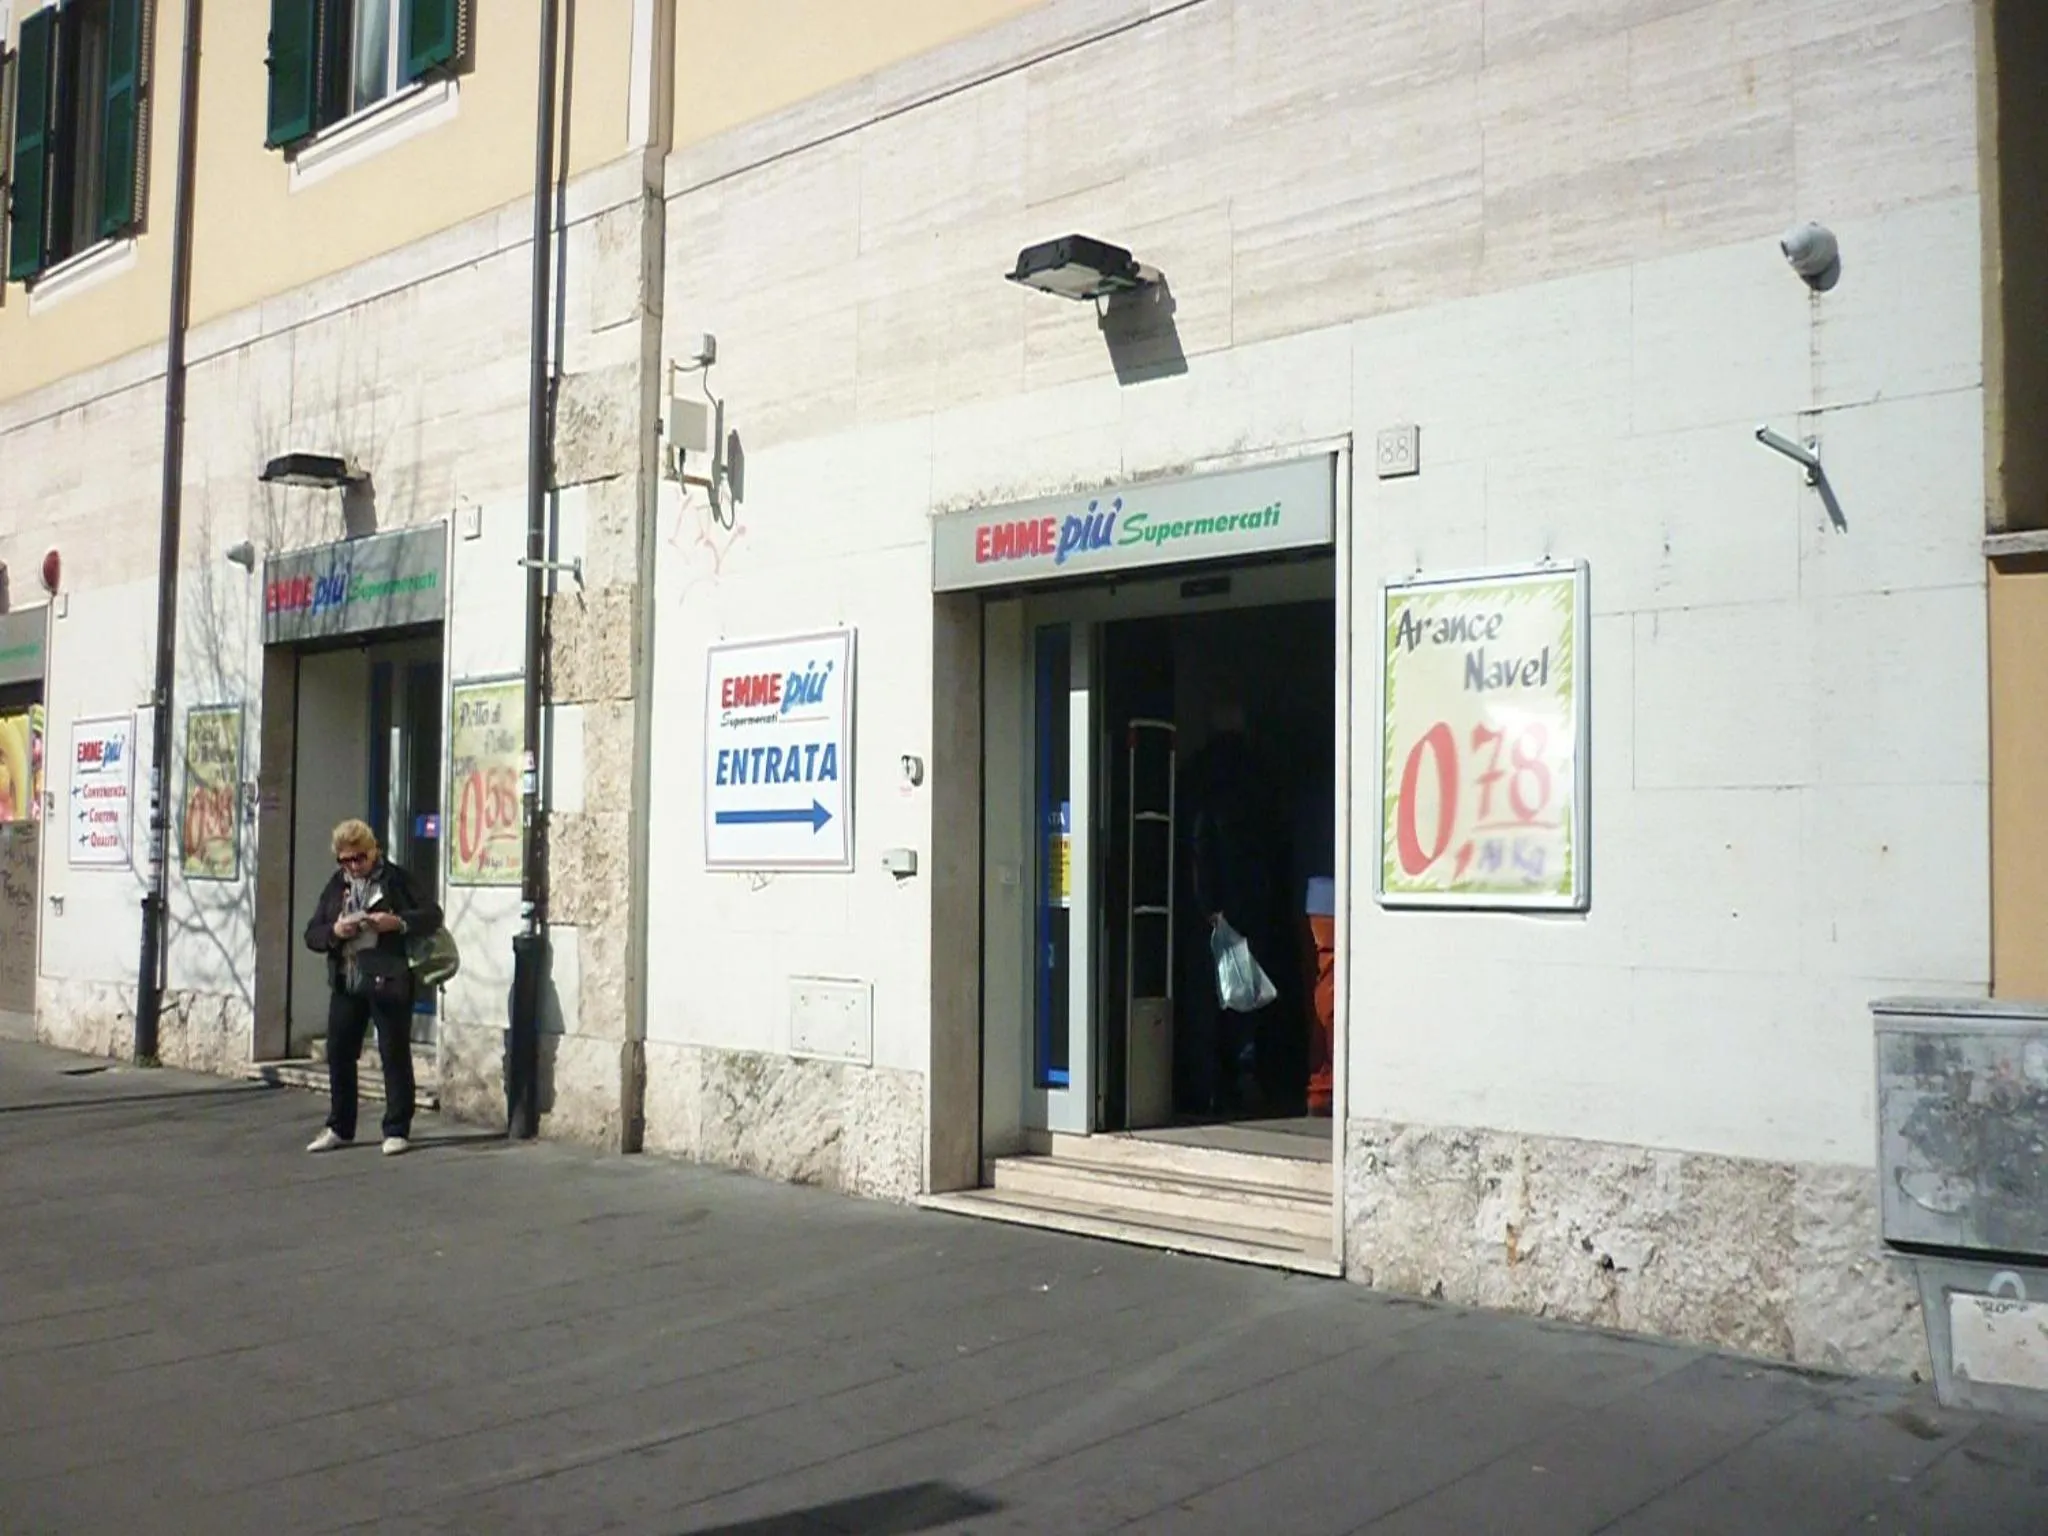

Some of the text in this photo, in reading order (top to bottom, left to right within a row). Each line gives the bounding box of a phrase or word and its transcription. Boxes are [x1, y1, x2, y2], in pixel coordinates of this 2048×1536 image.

[976, 517, 1057, 564] EMME
[1118, 502, 1281, 547] Supermercati
[1395, 608, 1504, 653] Arance
[721, 672, 783, 709] EMME
[1464, 646, 1549, 693] Navel
[715, 742, 838, 787] ENTRATA
